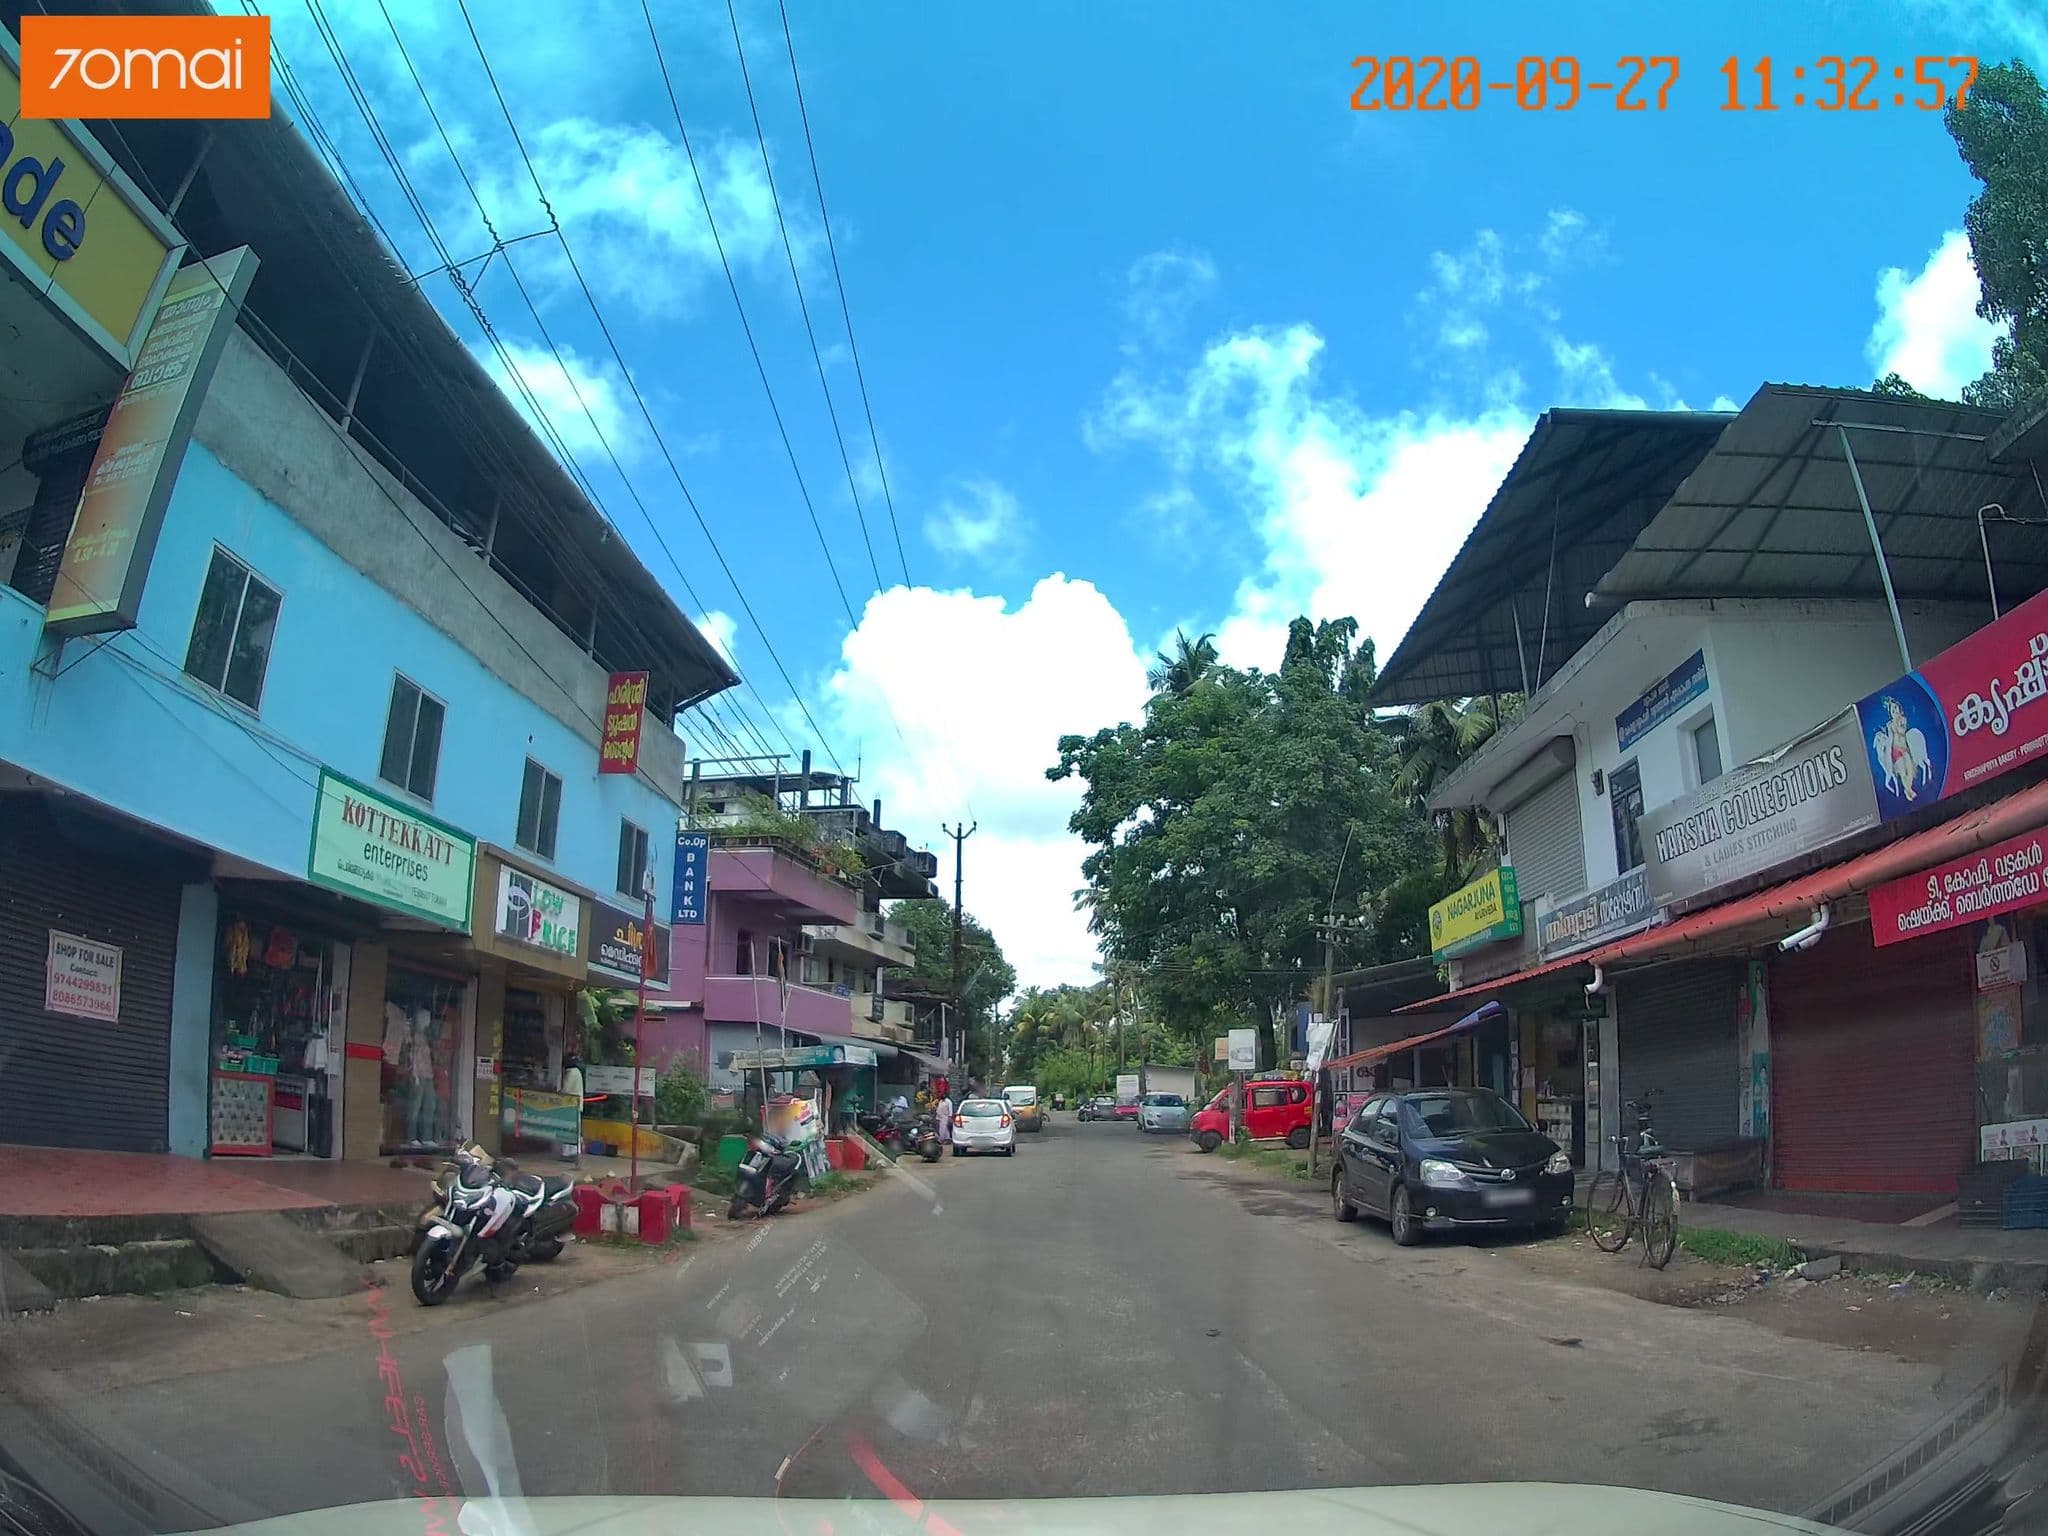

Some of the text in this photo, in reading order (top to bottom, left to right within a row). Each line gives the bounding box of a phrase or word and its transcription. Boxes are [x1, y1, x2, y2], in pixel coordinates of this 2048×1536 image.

[1655, 807, 1720, 863] HARSHA
[1720, 745, 1848, 835] COLLECTIONS
[342, 794, 455, 866] KOTTEKKATT
[677, 836, 706, 849] Co.Op
[1713, 837, 1745, 864] LADIES
[1746, 818, 1799, 851] STITCHING
[364, 841, 429, 882] enterprises
[533, 882, 564, 917] LOW
[678, 909, 697, 918] LTD
[1446, 880, 1496, 922] NAGARJUNA
[530, 908, 577, 956] PRICE
[55, 943, 114, 968] SHOP FOR SALE
